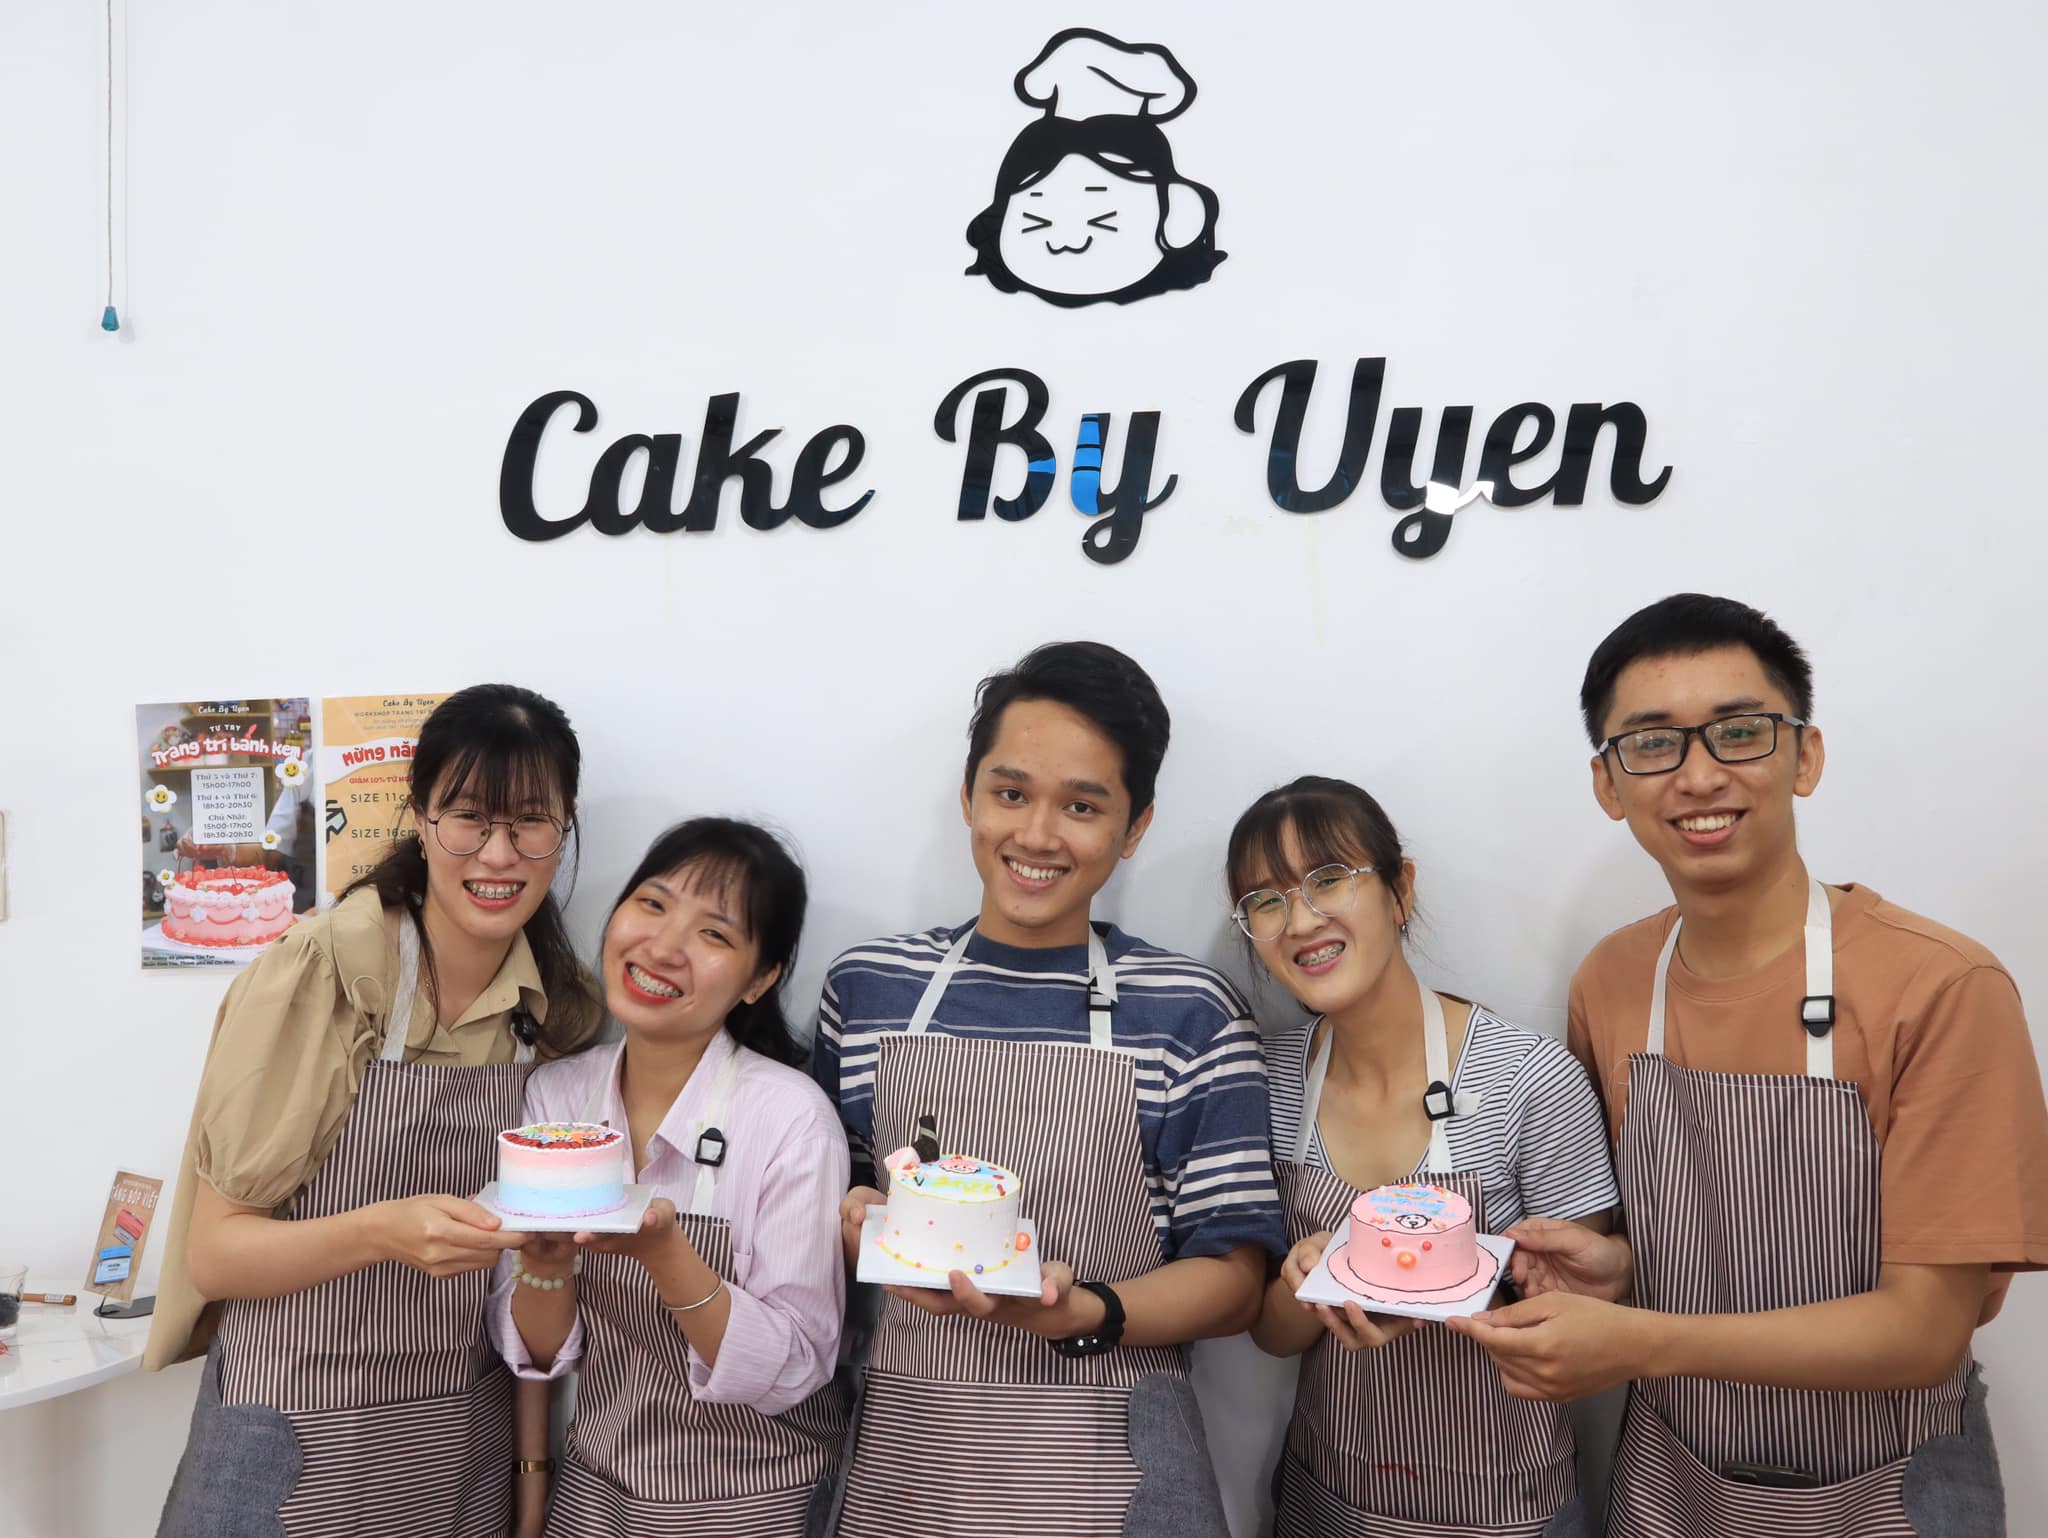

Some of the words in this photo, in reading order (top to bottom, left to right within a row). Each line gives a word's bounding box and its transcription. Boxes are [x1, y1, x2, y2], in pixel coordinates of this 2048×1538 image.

[500, 391, 876, 543] Cake
[934, 367, 1180, 567] By
[1234, 356, 1674, 560] Uyen
[383, 699, 400, 707] Cake
[402, 698, 413, 707] By
[198, 705, 215, 714] Cake
[218, 705, 229, 714] By
[224, 724, 241, 732] TAY
[202, 781, 252, 789] 15h00-17h00
[351, 793, 380, 803] SIZE
[385, 792, 407, 802] 11c
[351, 828, 380, 839] SIZE
